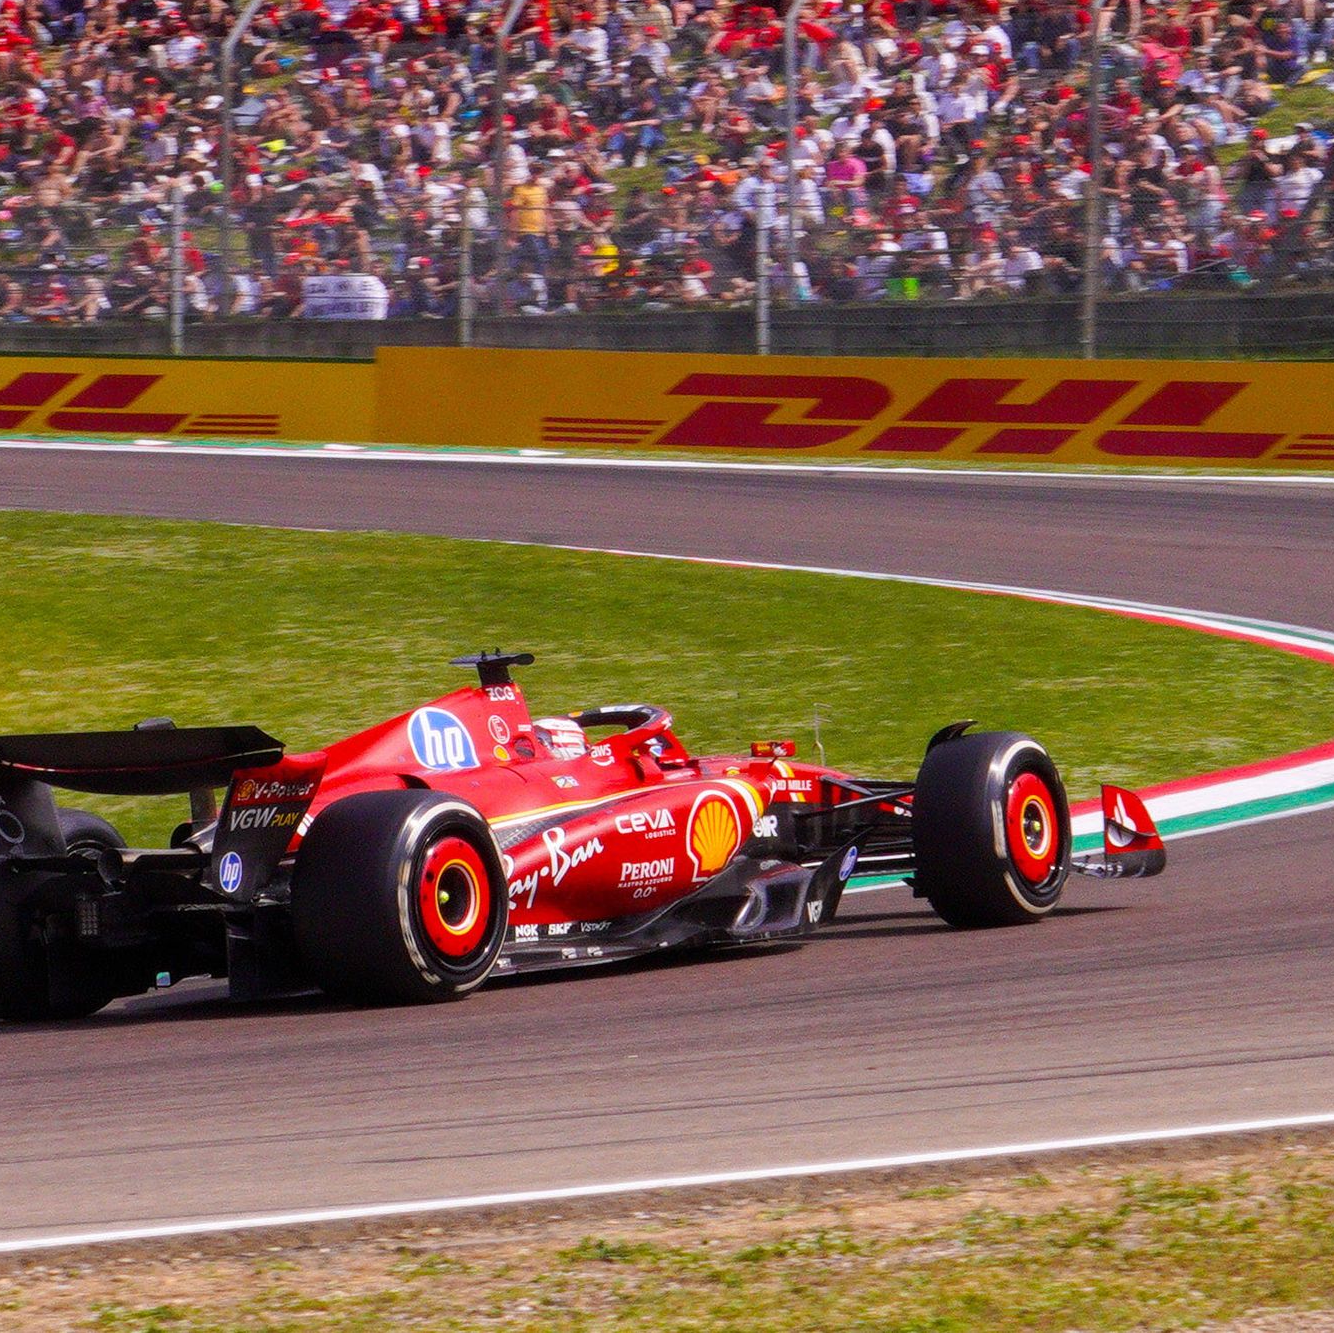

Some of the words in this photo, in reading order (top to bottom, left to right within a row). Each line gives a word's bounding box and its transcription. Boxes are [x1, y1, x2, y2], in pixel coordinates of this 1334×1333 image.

[655, 373, 1287, 457] DHL
[416, 708, 468, 769] hp
[590, 743, 612, 758] aws
[255, 781, 314, 799] V-Power
[787, 779, 812, 791] MILLE
[230, 806, 278, 831] VGW
[271, 812, 299, 826] PLAY
[644, 828, 677, 839] LOGISTICS
[222, 853, 240, 892] hp
[620, 857, 675, 881] PERONI
[515, 923, 539, 937] NGK
[547, 922, 573, 935] SKF
